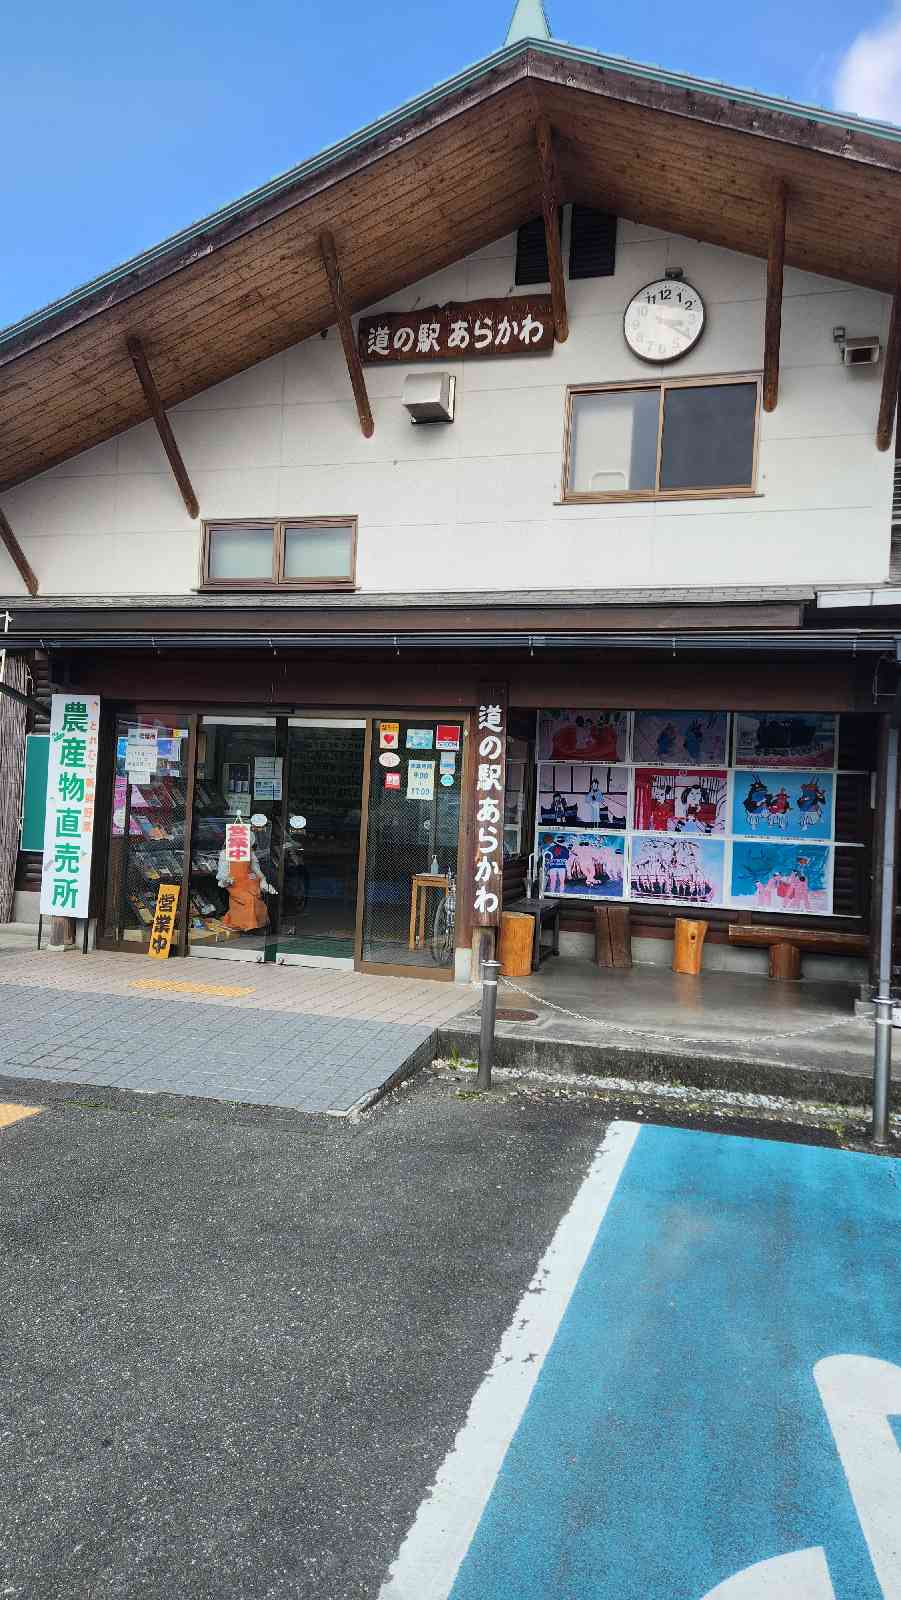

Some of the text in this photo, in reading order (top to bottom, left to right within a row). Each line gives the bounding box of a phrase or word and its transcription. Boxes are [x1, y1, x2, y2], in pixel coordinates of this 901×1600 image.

[646, 294, 656, 305] 11
[658, 289, 673, 300] 12
[677, 292, 682, 304] 1
[684, 300, 693, 311] 2
[52, 701, 89, 909] 農産物直売所
[474, 704, 503, 913] 道の駅あらかわ
[228, 825, 249, 860] 営業中
[152, 893, 176, 953] 営業中
